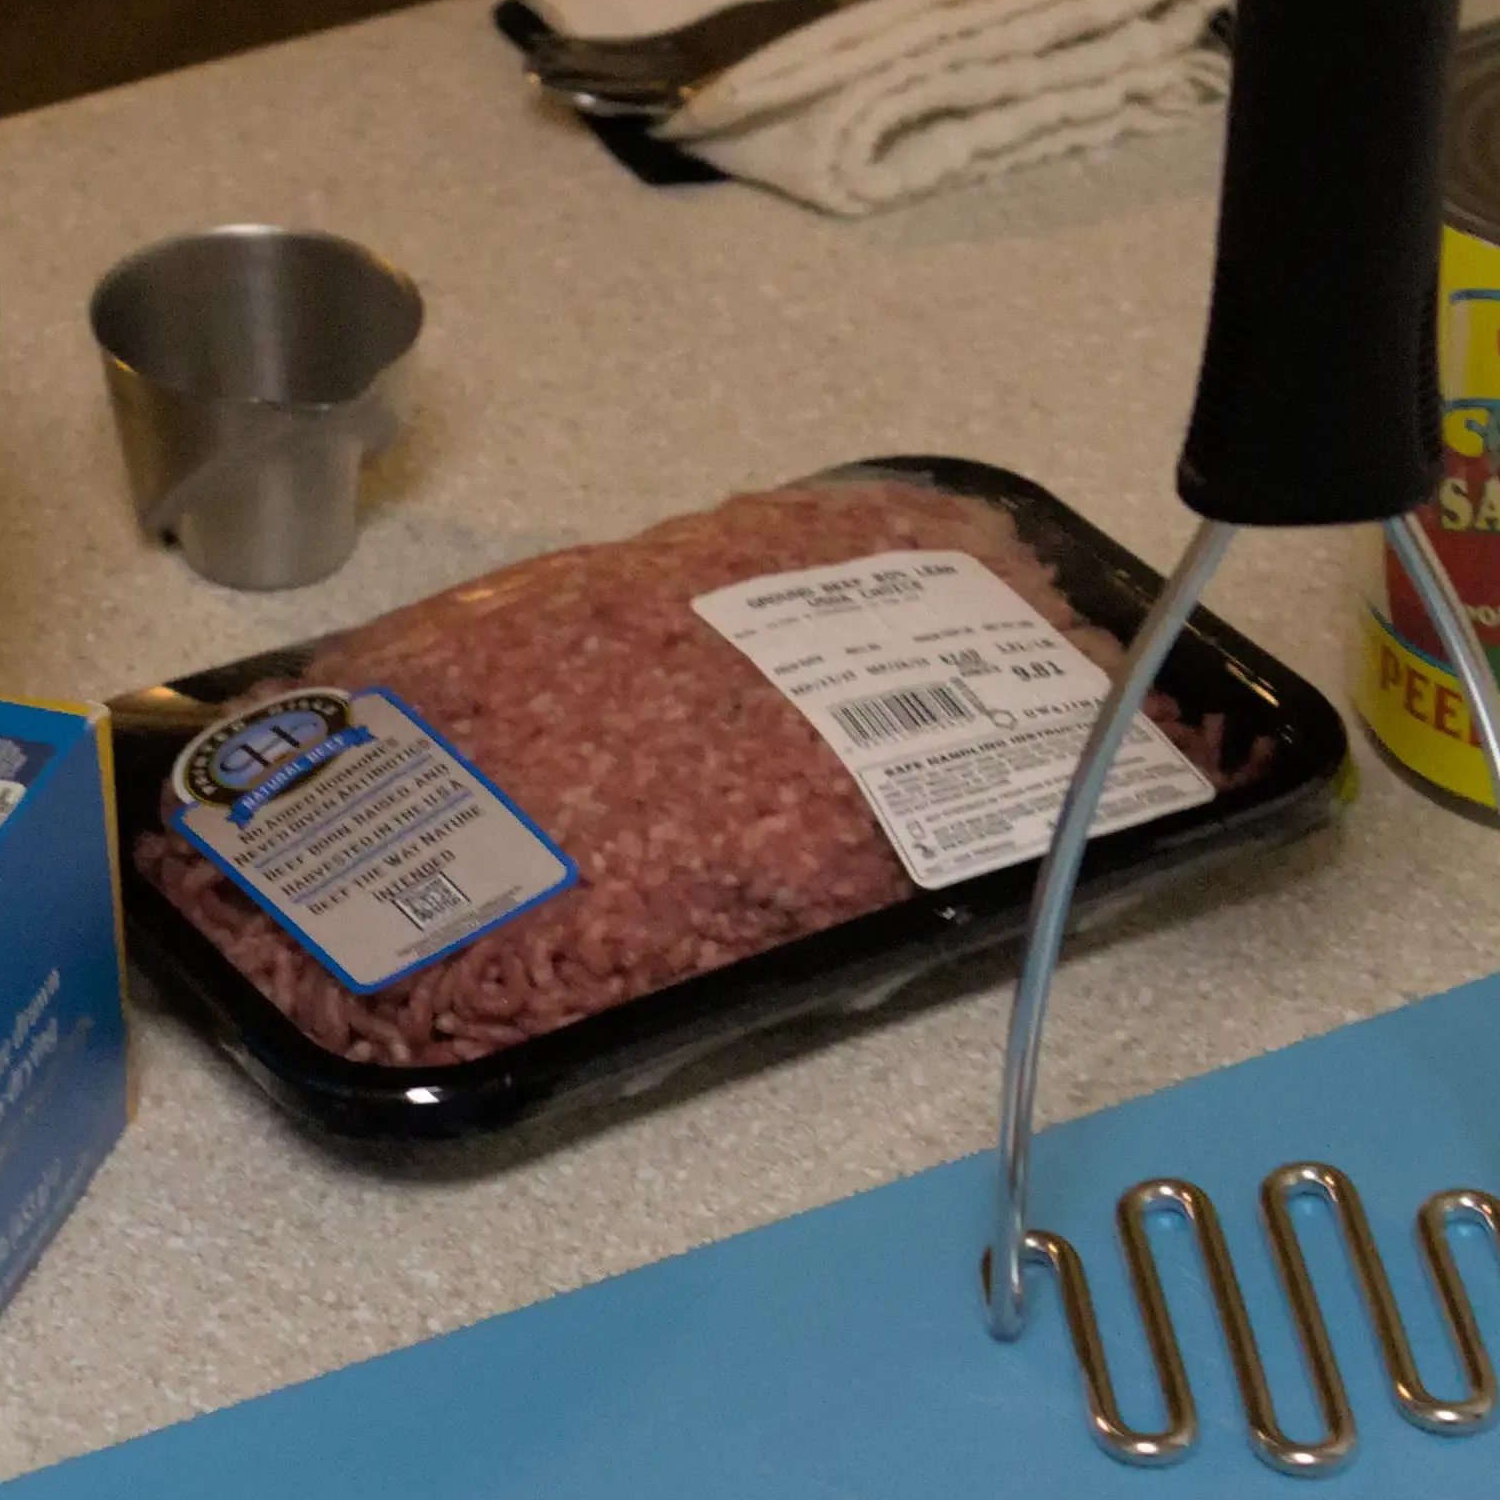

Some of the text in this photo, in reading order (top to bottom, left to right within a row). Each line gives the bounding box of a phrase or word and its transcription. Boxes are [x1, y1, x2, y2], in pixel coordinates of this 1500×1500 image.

[821, 576, 862, 593] BEEF
[913, 563, 959, 578] LEAN
[1010, 659, 1066, 683] 9.81
[240, 734, 346, 811] NATURAL BEEF
[413, 762, 451, 790] AND
[883, 761, 925, 777] SAFE
[927, 737, 1008, 767] HANDLING
[233, 826, 295, 867] NEVER
[280, 835, 375, 899] HARVESTED
[371, 821, 394, 841] IN
[393, 800, 423, 830] THE
[305, 804, 483, 917] BEEF THE WAY NATURE
[371, 849, 457, 904] INTENDED
